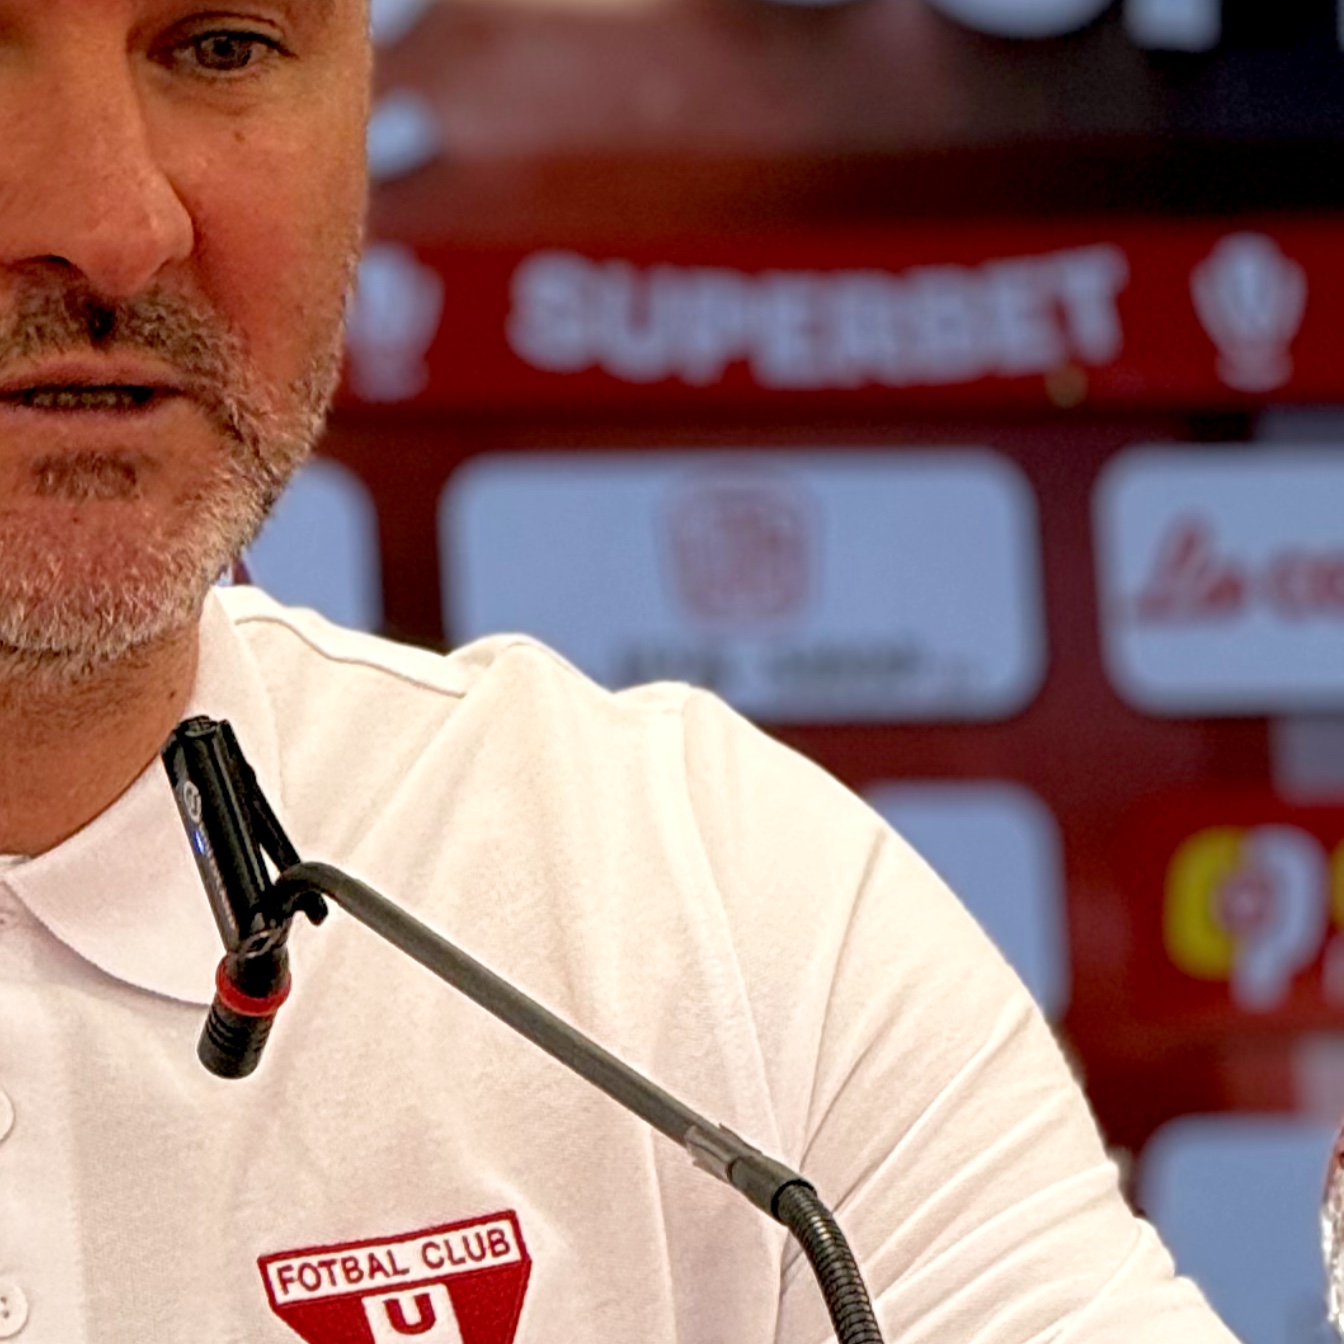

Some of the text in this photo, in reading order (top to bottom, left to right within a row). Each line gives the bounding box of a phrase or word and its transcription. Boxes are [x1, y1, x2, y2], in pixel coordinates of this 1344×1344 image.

[507, 244, 1129, 389] SUPERBET
[277, 1228, 511, 1295] FOTBAL CLUB
